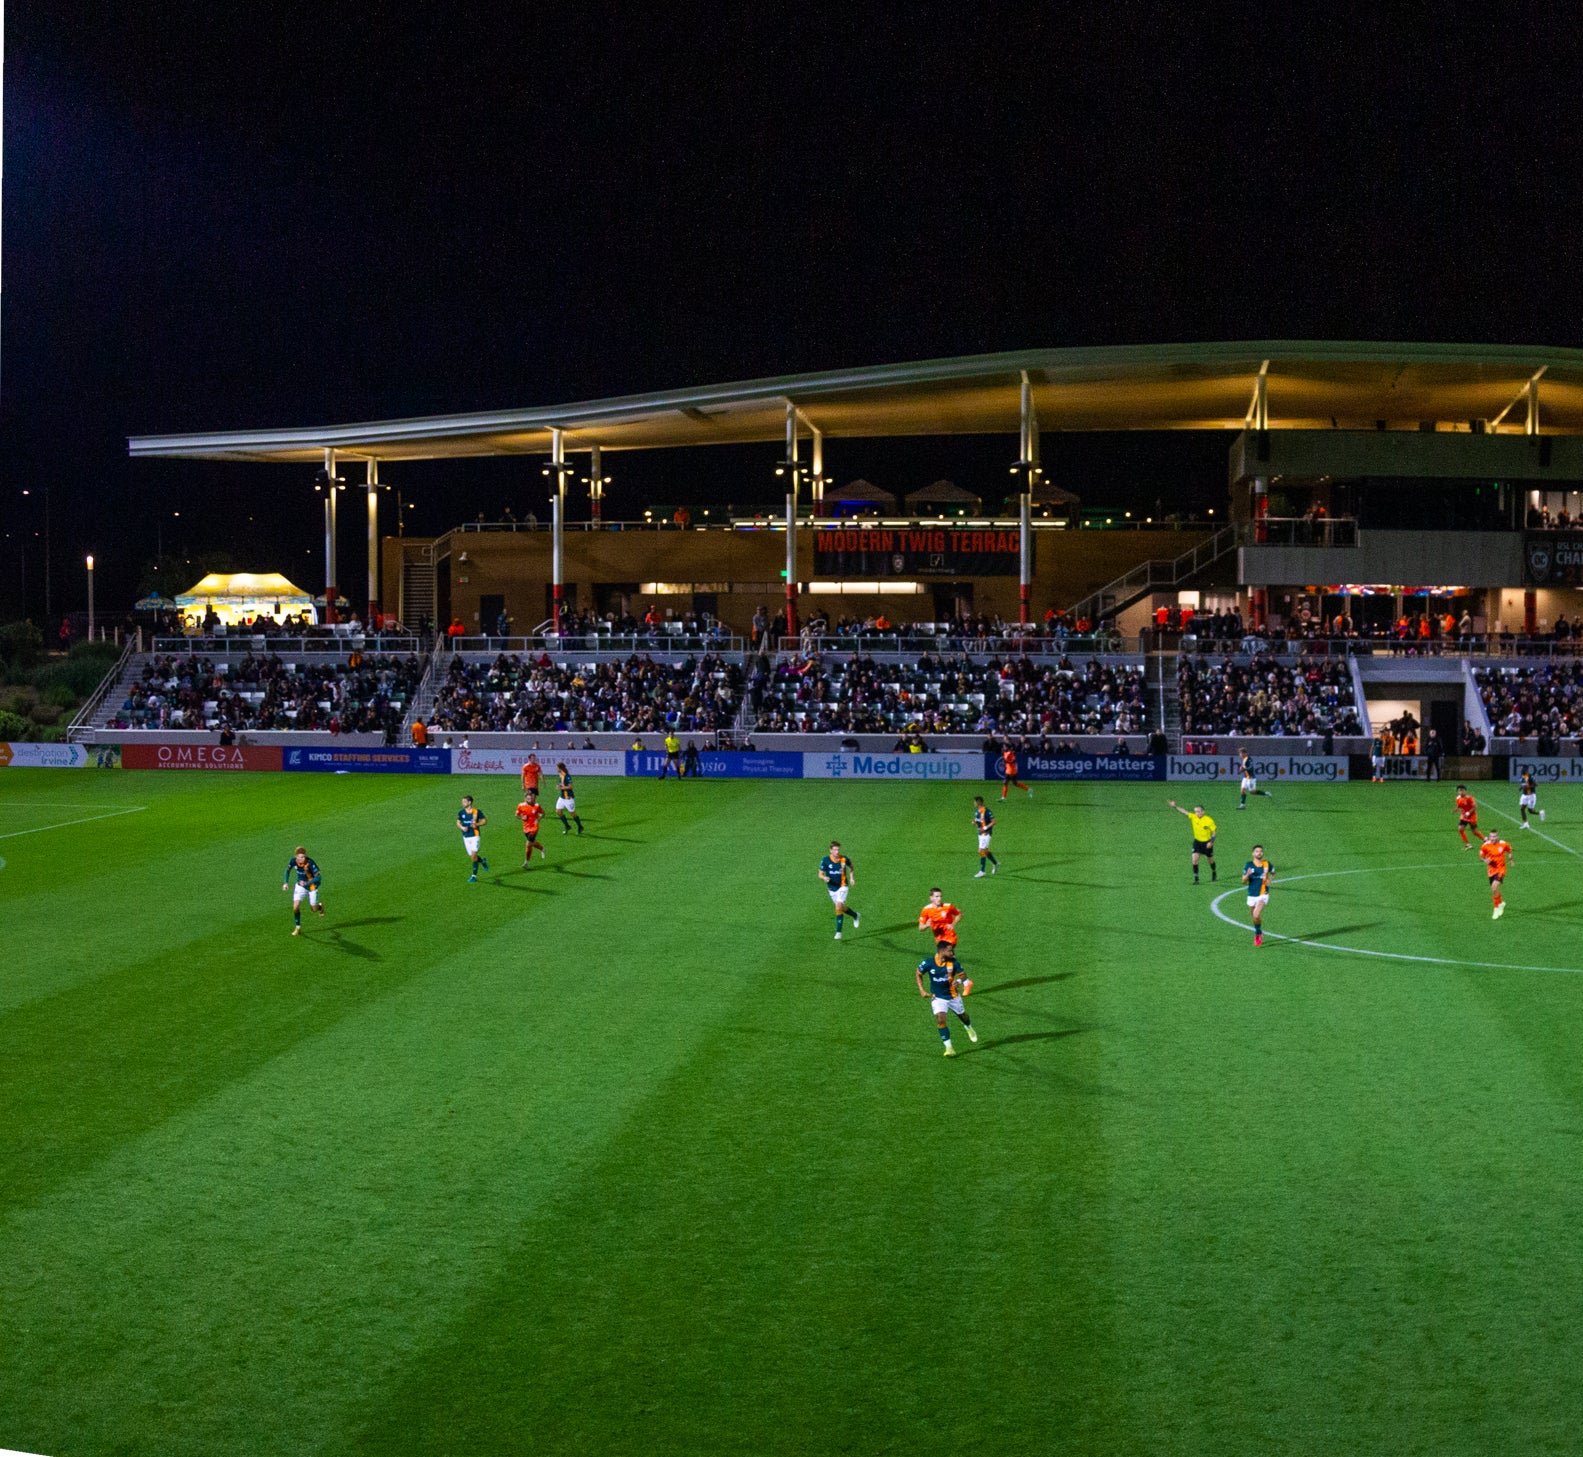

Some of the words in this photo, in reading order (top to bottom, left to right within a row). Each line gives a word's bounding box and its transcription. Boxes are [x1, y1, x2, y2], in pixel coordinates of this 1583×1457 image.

[817, 532, 894, 552] MODERN
[898, 533, 946, 551] TWIG
[952, 533, 1021, 552] TERRAC
[158, 746, 244, 762] OMEGA
[308, 753, 333, 762] KIMCO
[333, 753, 371, 763] STAFFING
[372, 754, 410, 763] SERVICES
[587, 758, 619, 766] CENTER
[158, 761, 201, 769] ACCOUNTING
[205, 762, 244, 770] SOLUTIONS
[742, 765, 768, 774] Physical
[769, 766, 795, 774] Therapy
[853, 756, 962, 778] Medequip
[1027, 757, 1093, 773] Massage
[1096, 757, 1155, 771] Matters
[1170, 756, 1227, 780] hoag.
[1230, 757, 1286, 780] hag.
[1289, 757, 1345, 781] hoag.
